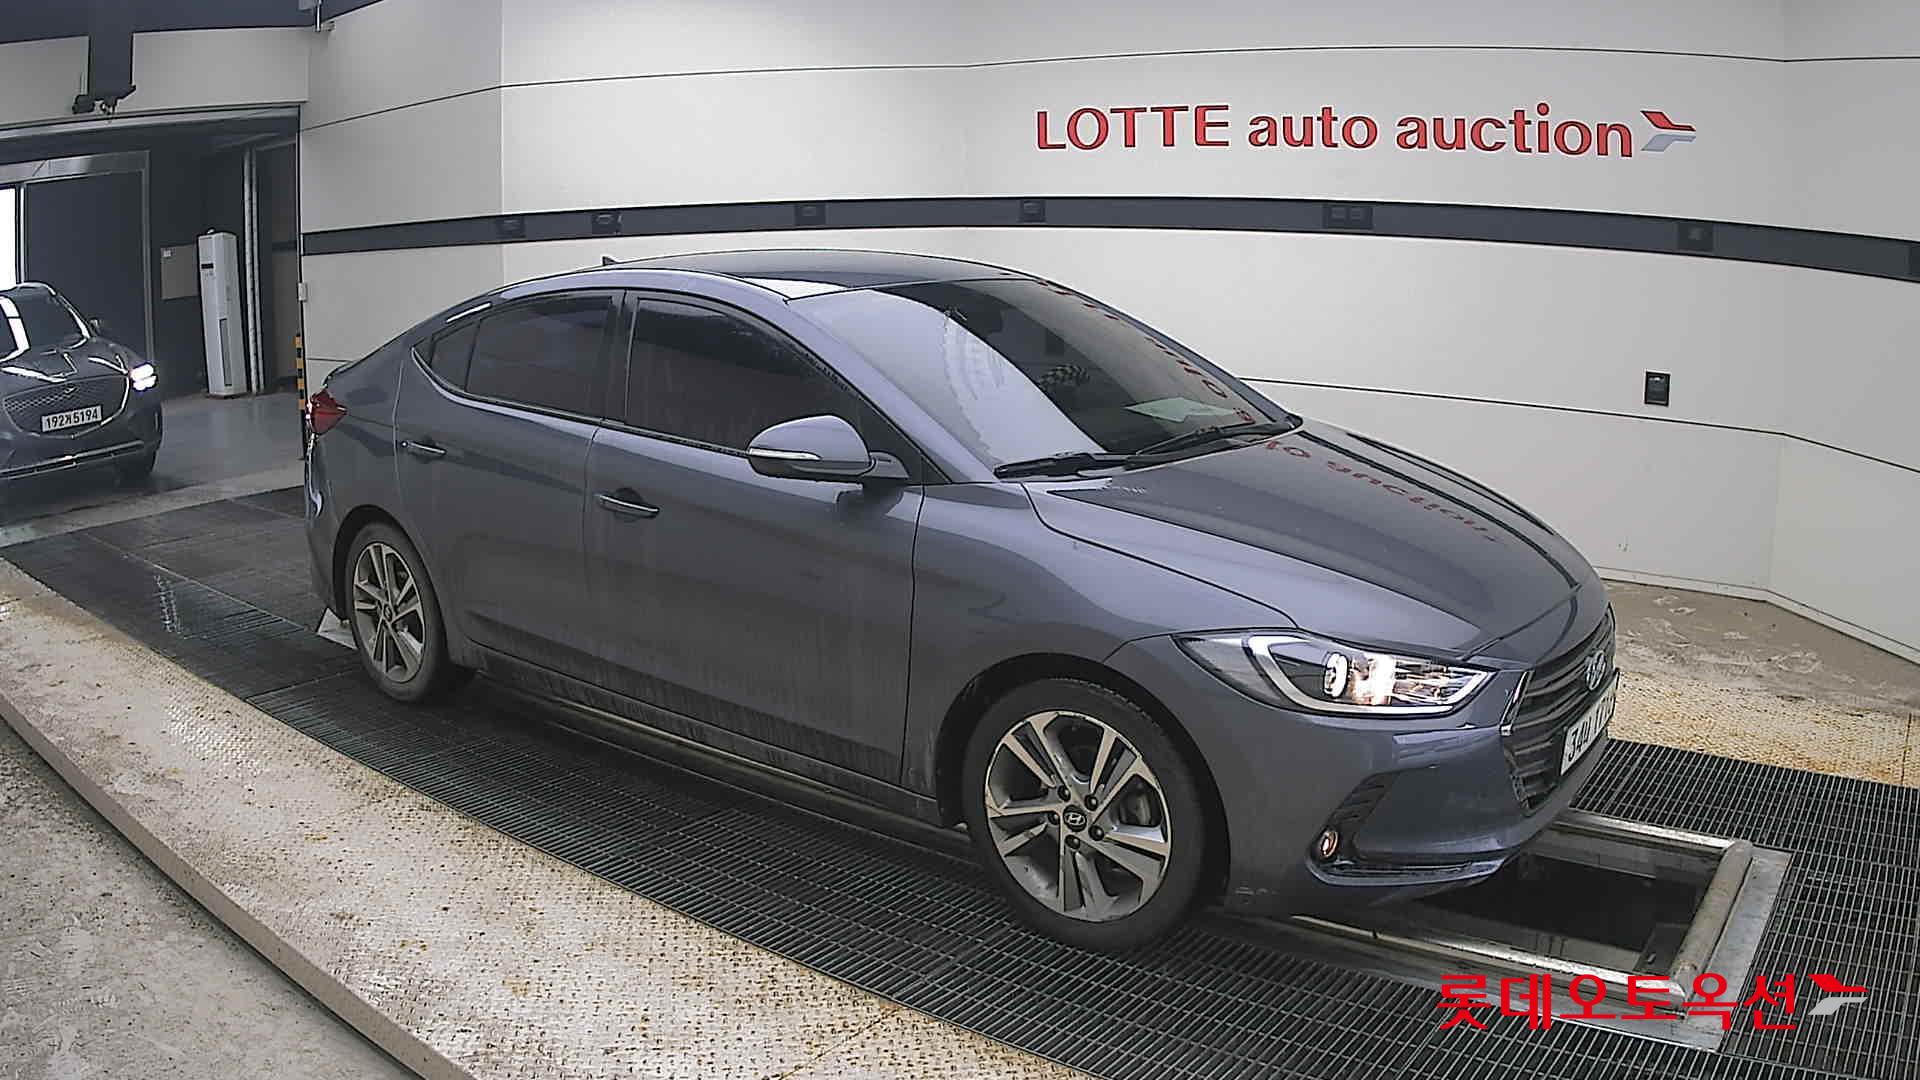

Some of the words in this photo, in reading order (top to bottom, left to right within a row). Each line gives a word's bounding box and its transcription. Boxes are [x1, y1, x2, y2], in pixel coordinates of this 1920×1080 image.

[1036, 104, 1229, 150] LOTTE
[1249, 107, 1378, 149] auto
[1396, 103, 1634, 158] auction
